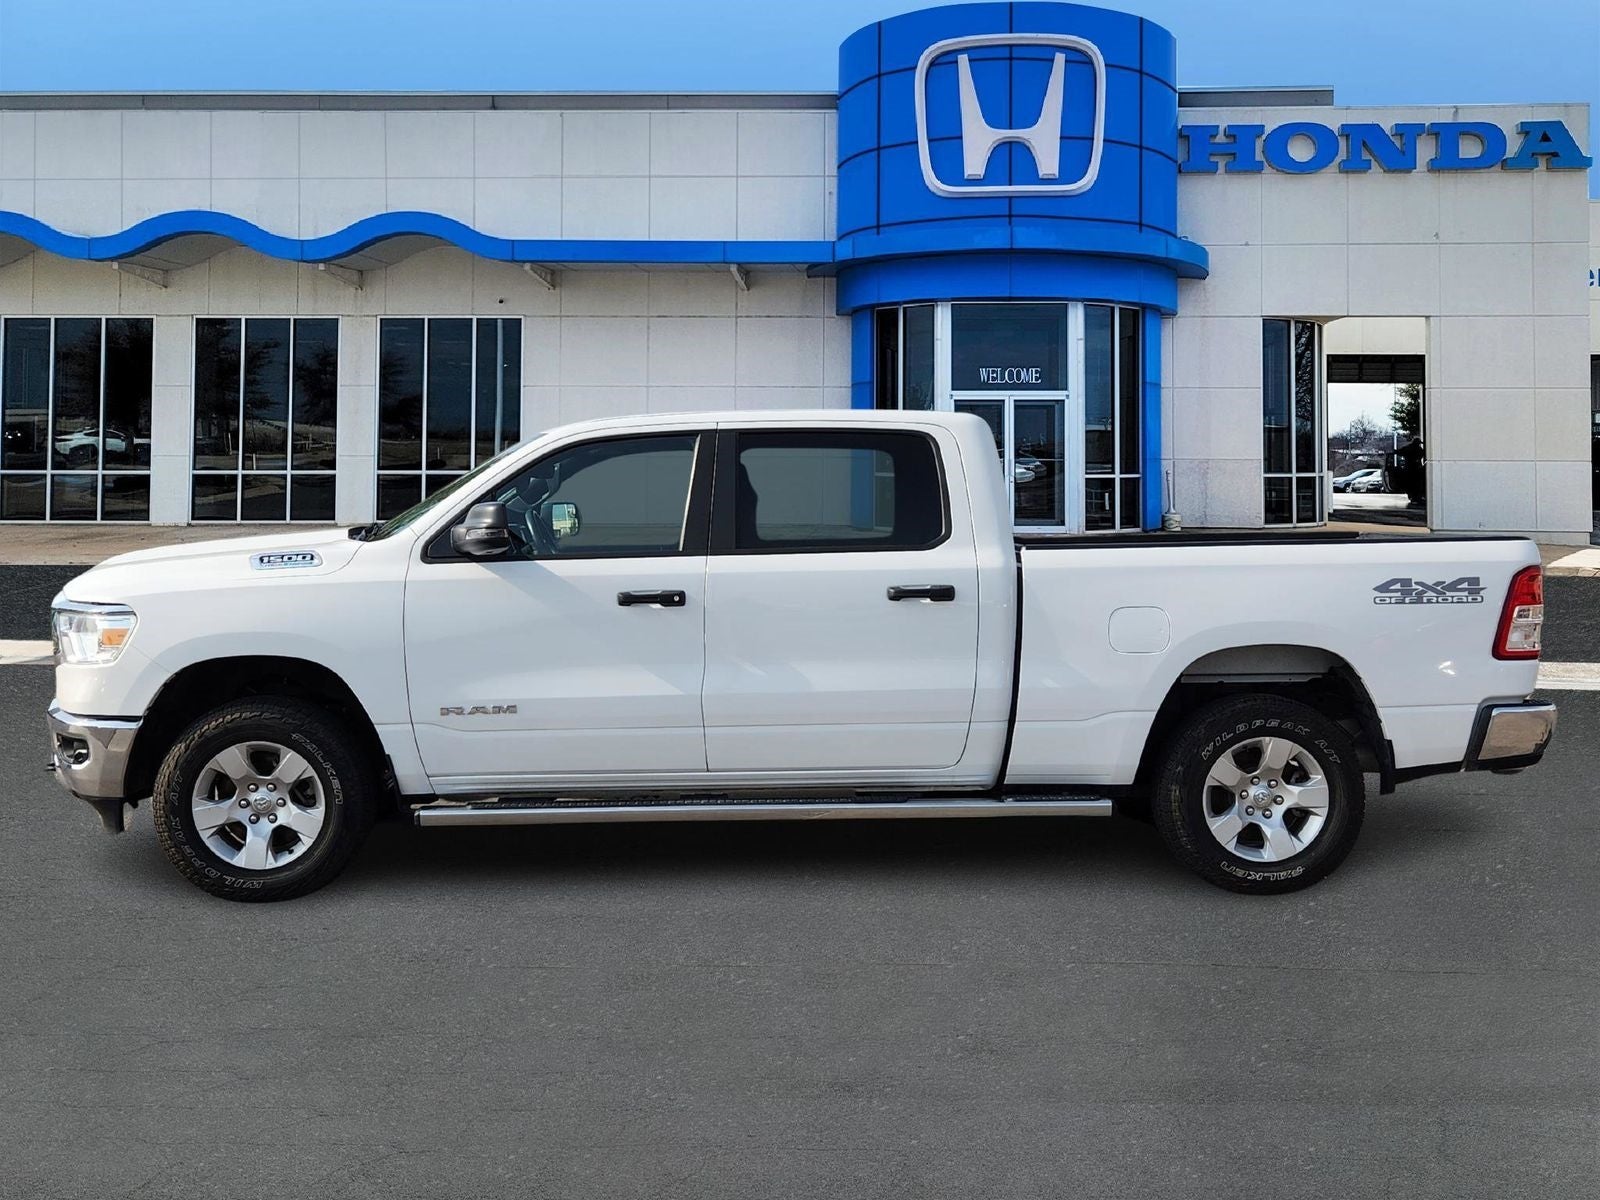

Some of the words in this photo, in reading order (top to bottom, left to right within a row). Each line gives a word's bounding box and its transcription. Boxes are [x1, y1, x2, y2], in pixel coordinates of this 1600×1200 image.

[1180, 120, 1593, 174] HONDA
[979, 367, 1042, 384] WELCOME
[261, 554, 313, 564] 1500
[1372, 576, 1487, 595] 4x4
[1423, 596, 1483, 604] ROAD
[440, 705, 517, 716] RAM
[1201, 719, 1311, 761] WILDPEAK
[291, 732, 344, 805] FALKEN
[1220, 861, 1306, 881] FALKEN
